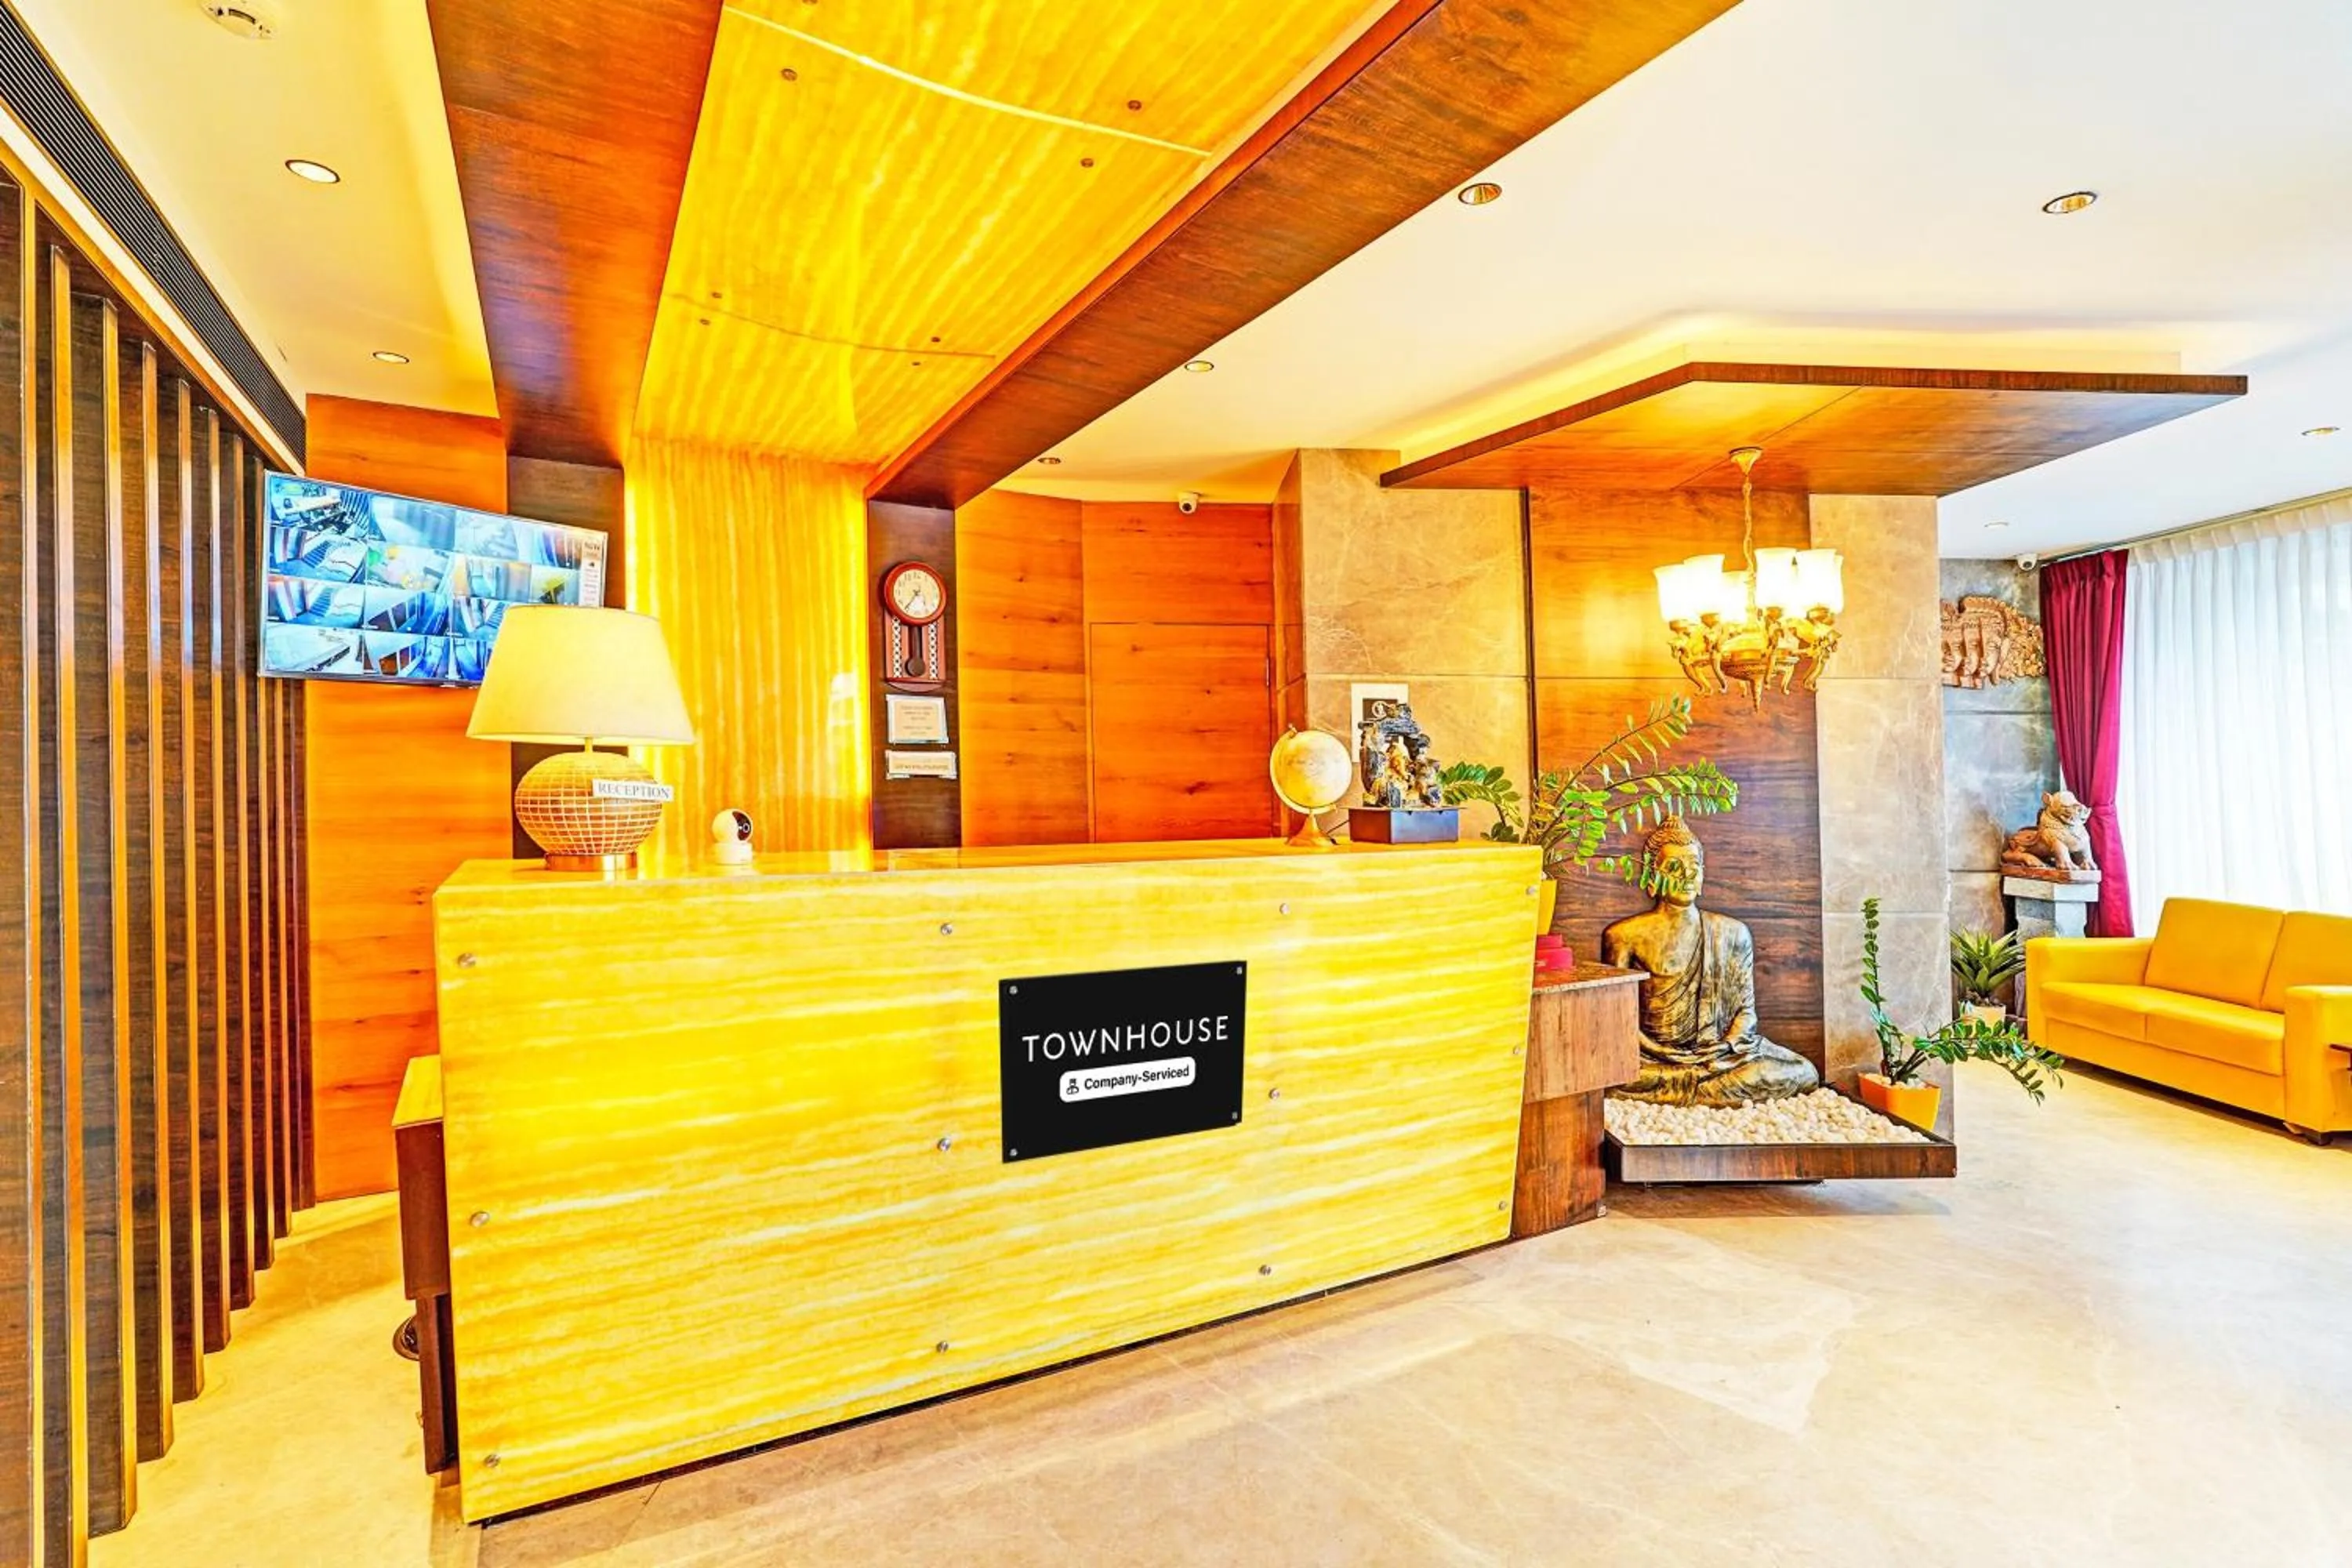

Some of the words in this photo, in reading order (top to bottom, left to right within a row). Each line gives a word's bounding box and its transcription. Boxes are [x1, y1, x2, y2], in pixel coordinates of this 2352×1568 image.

[598, 782, 670, 798] RECEPTION
[1022, 1015, 1229, 1062] TOWNHOUSE
[1084, 1064, 1190, 1090] Company-Serviced
